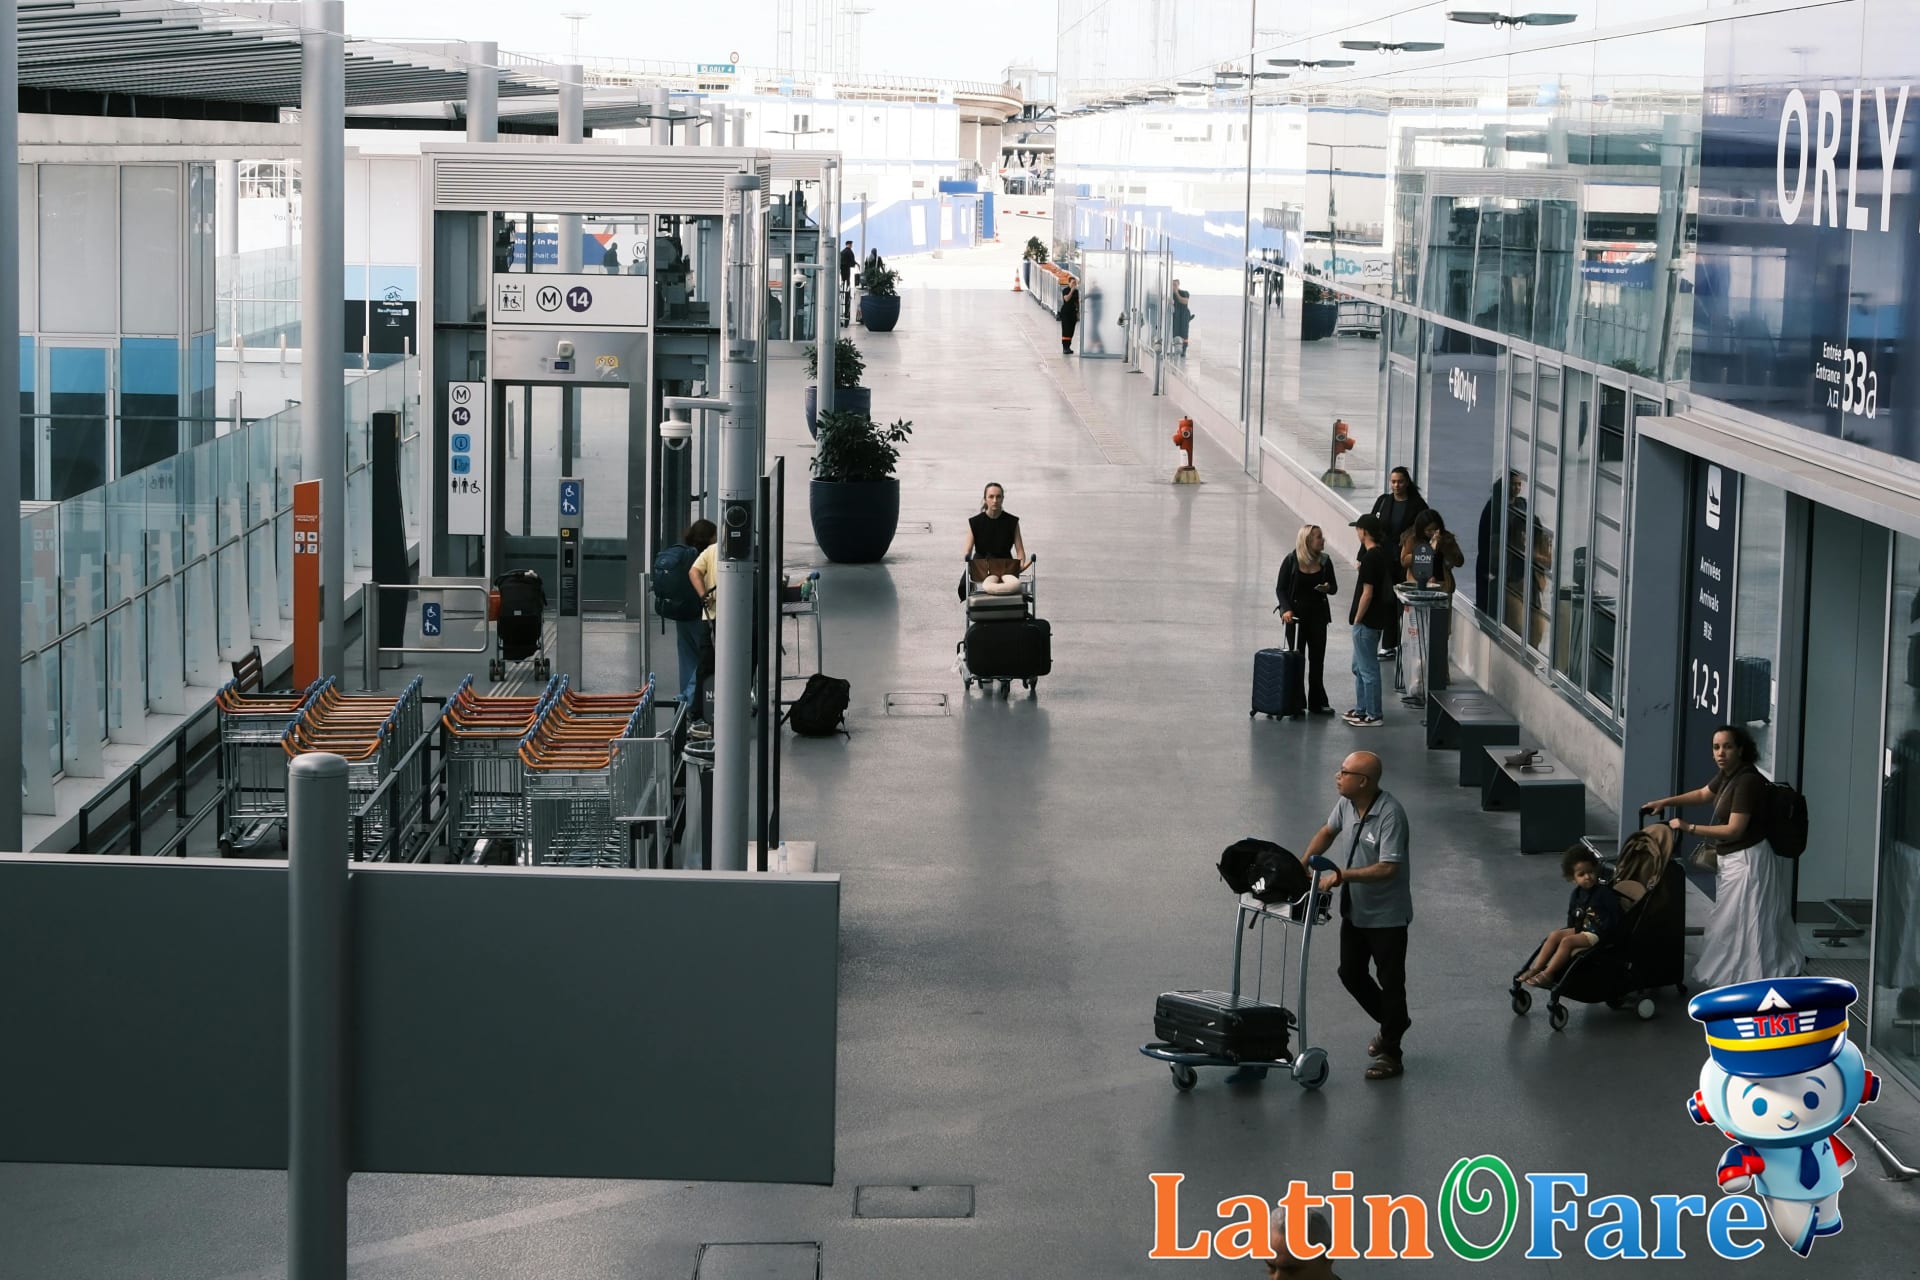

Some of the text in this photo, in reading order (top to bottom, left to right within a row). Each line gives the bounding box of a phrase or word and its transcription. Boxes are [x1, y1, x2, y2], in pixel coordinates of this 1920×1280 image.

[1776, 85, 1910, 232] ORLY
[569, 291, 590, 308] 14
[1823, 341, 1842, 362] Entrée
[1815, 362, 1841, 385] Entrance
[1826, 387, 1840, 410] 入口
[454, 410, 469, 423] 14
[1700, 555, 1721, 582] Arrivées
[1699, 587, 1719, 613] Arrivals
